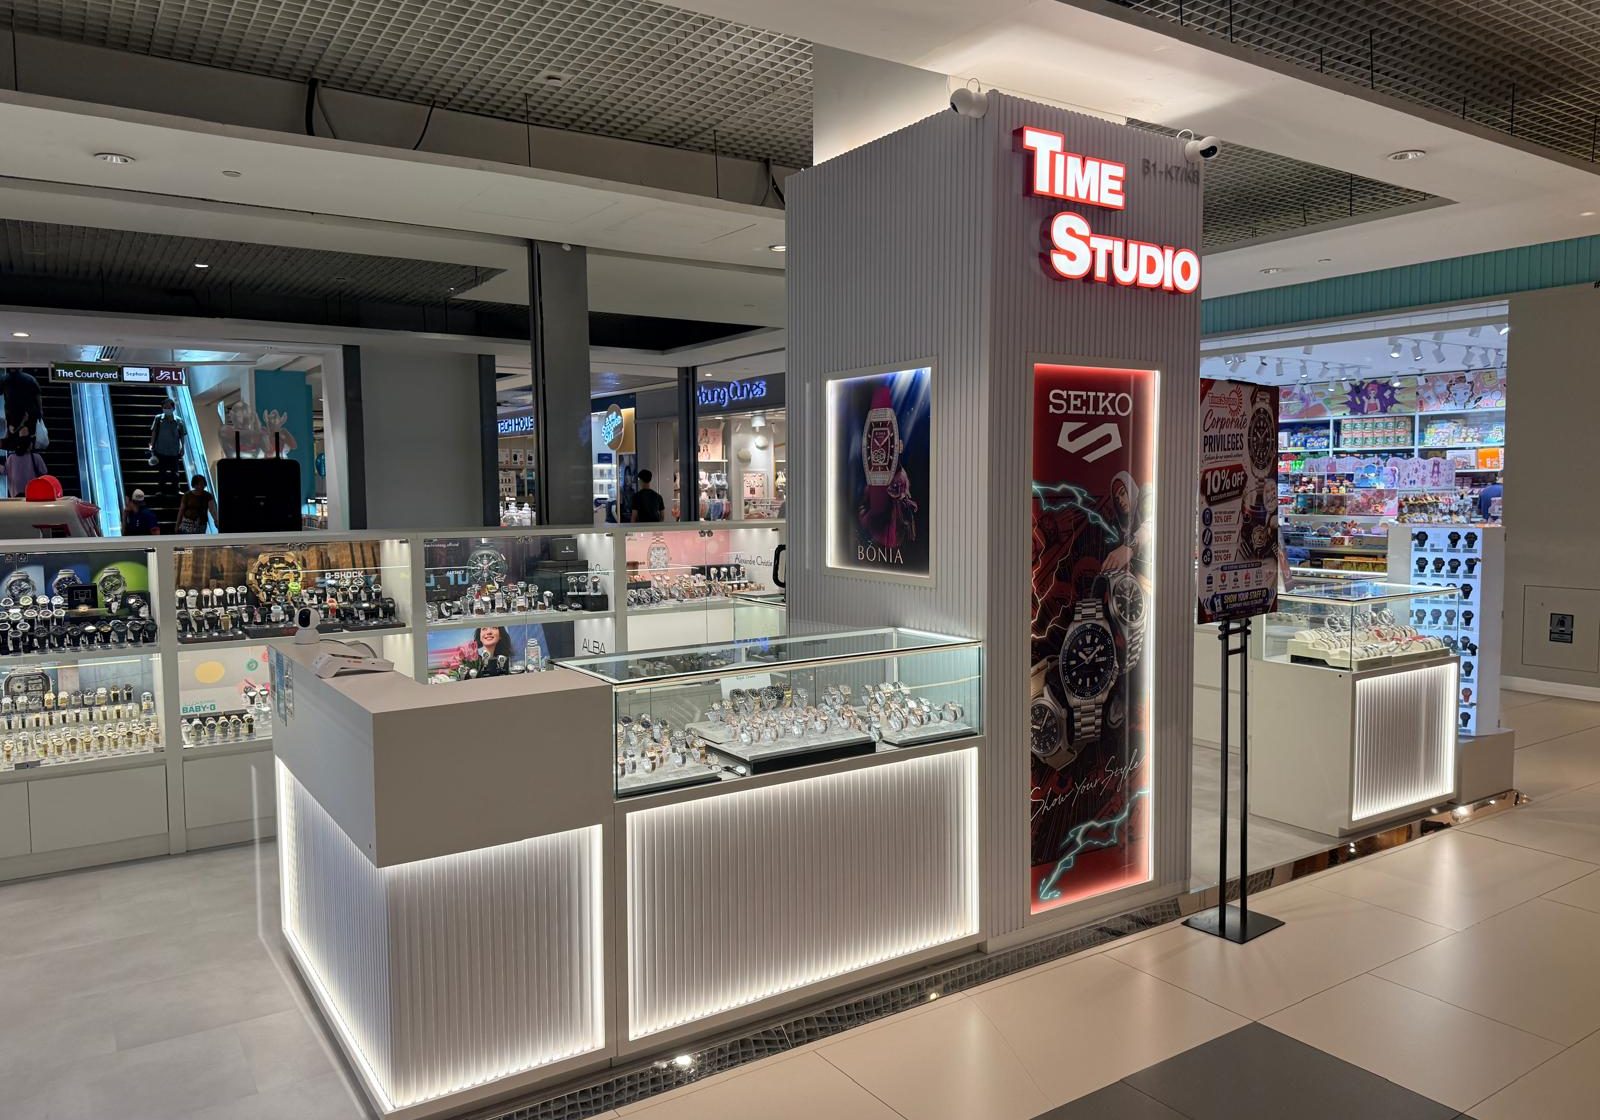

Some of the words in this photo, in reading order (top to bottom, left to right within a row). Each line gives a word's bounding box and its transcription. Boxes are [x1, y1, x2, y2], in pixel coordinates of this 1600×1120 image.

[56, 369, 73, 378] The
[74, 369, 118, 382] Courtyard
[172, 371, 183, 381] L1
[729, 381, 767, 400] Curves
[1048, 389, 1133, 417] SEIKO
[1203, 408, 1248, 434] Corporate
[1203, 432, 1244, 453] PRIVILEGES
[1205, 469, 1231, 497] 10%
[1231, 471, 1245, 488] OFF
[1223, 515, 1232, 523] OFF
[1223, 534, 1232, 542] OFF
[857, 545, 904, 565] BONIA
[1223, 553, 1232, 561] OFF
[324, 571, 364, 580] G-SHOCK
[582, 637, 606, 655] ALBA
[182, 703, 216, 714] BABY-G
[1072, 777, 1101, 807] Your
